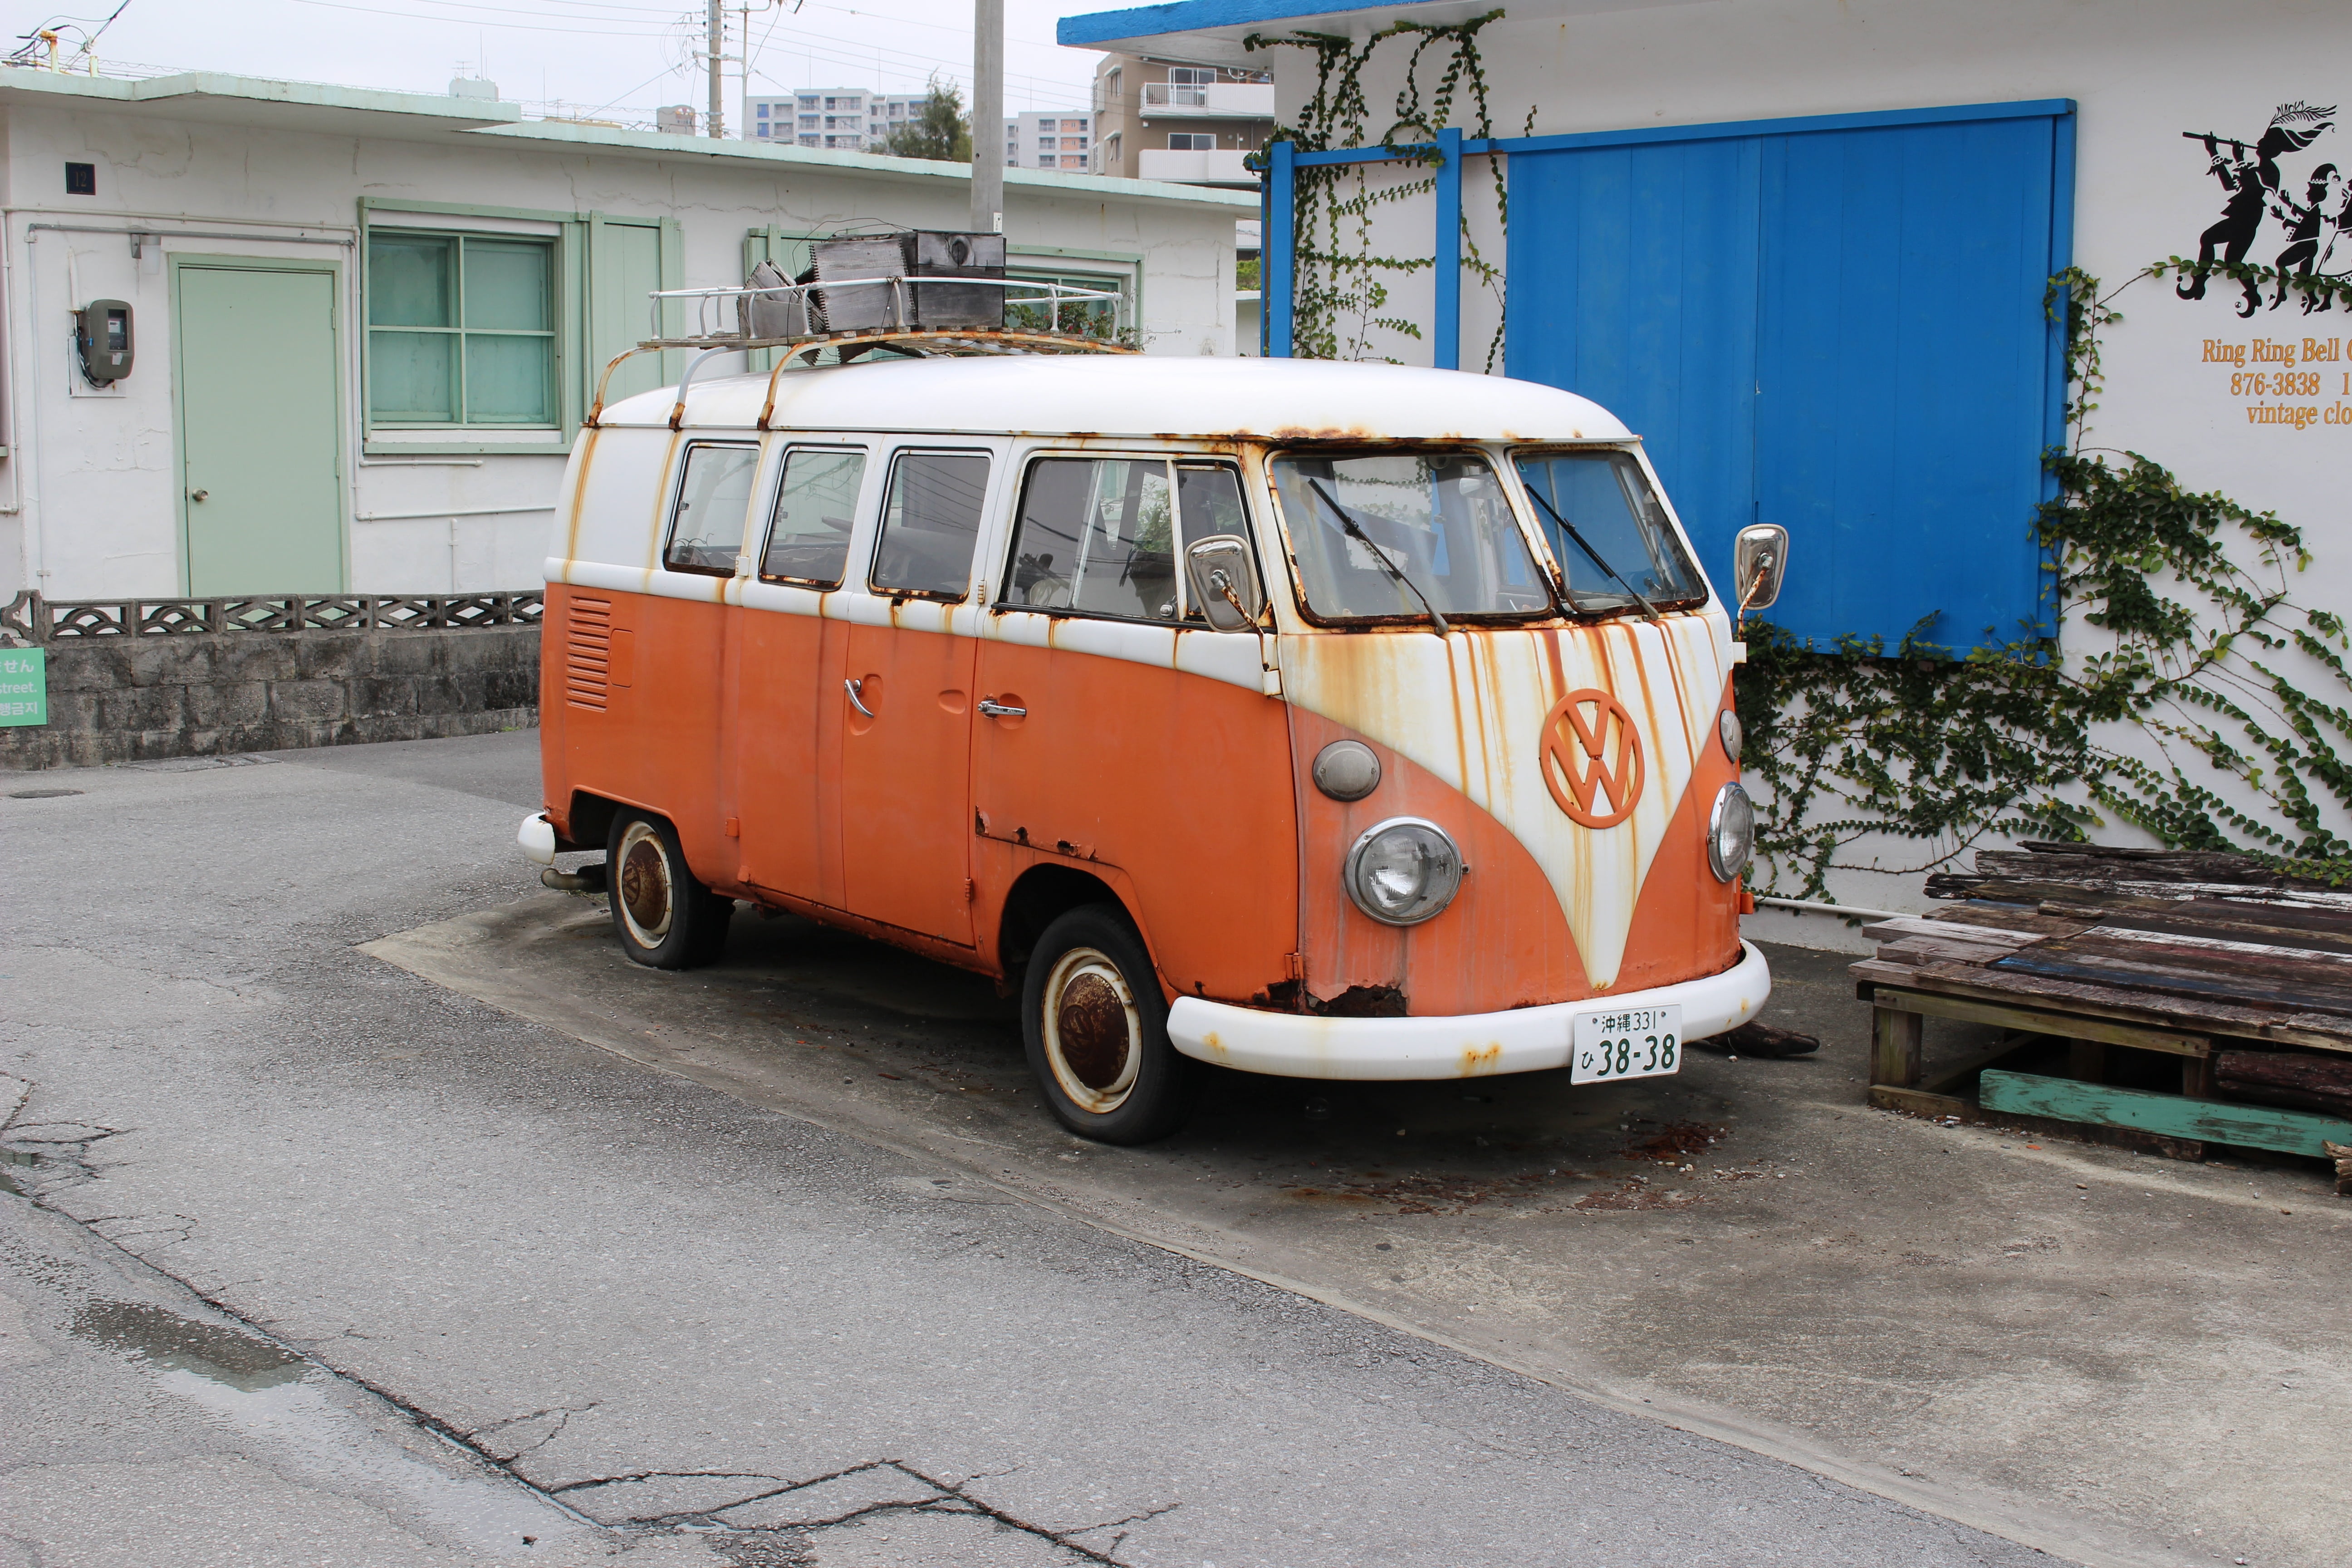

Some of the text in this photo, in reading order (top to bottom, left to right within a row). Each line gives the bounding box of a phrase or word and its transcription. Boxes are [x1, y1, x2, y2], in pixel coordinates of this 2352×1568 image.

[75, 171, 87, 187] 12
[2202, 339, 2246, 368] Ring
[2252, 338, 2296, 368] Ring
[2301, 338, 2340, 362] Bell
[2230, 372, 2320, 396] 876-3838
[2246, 401, 2318, 430] vintage
[1539, 688, 1645, 829] VW
[1597, 1034, 1675, 1076] 38-38
